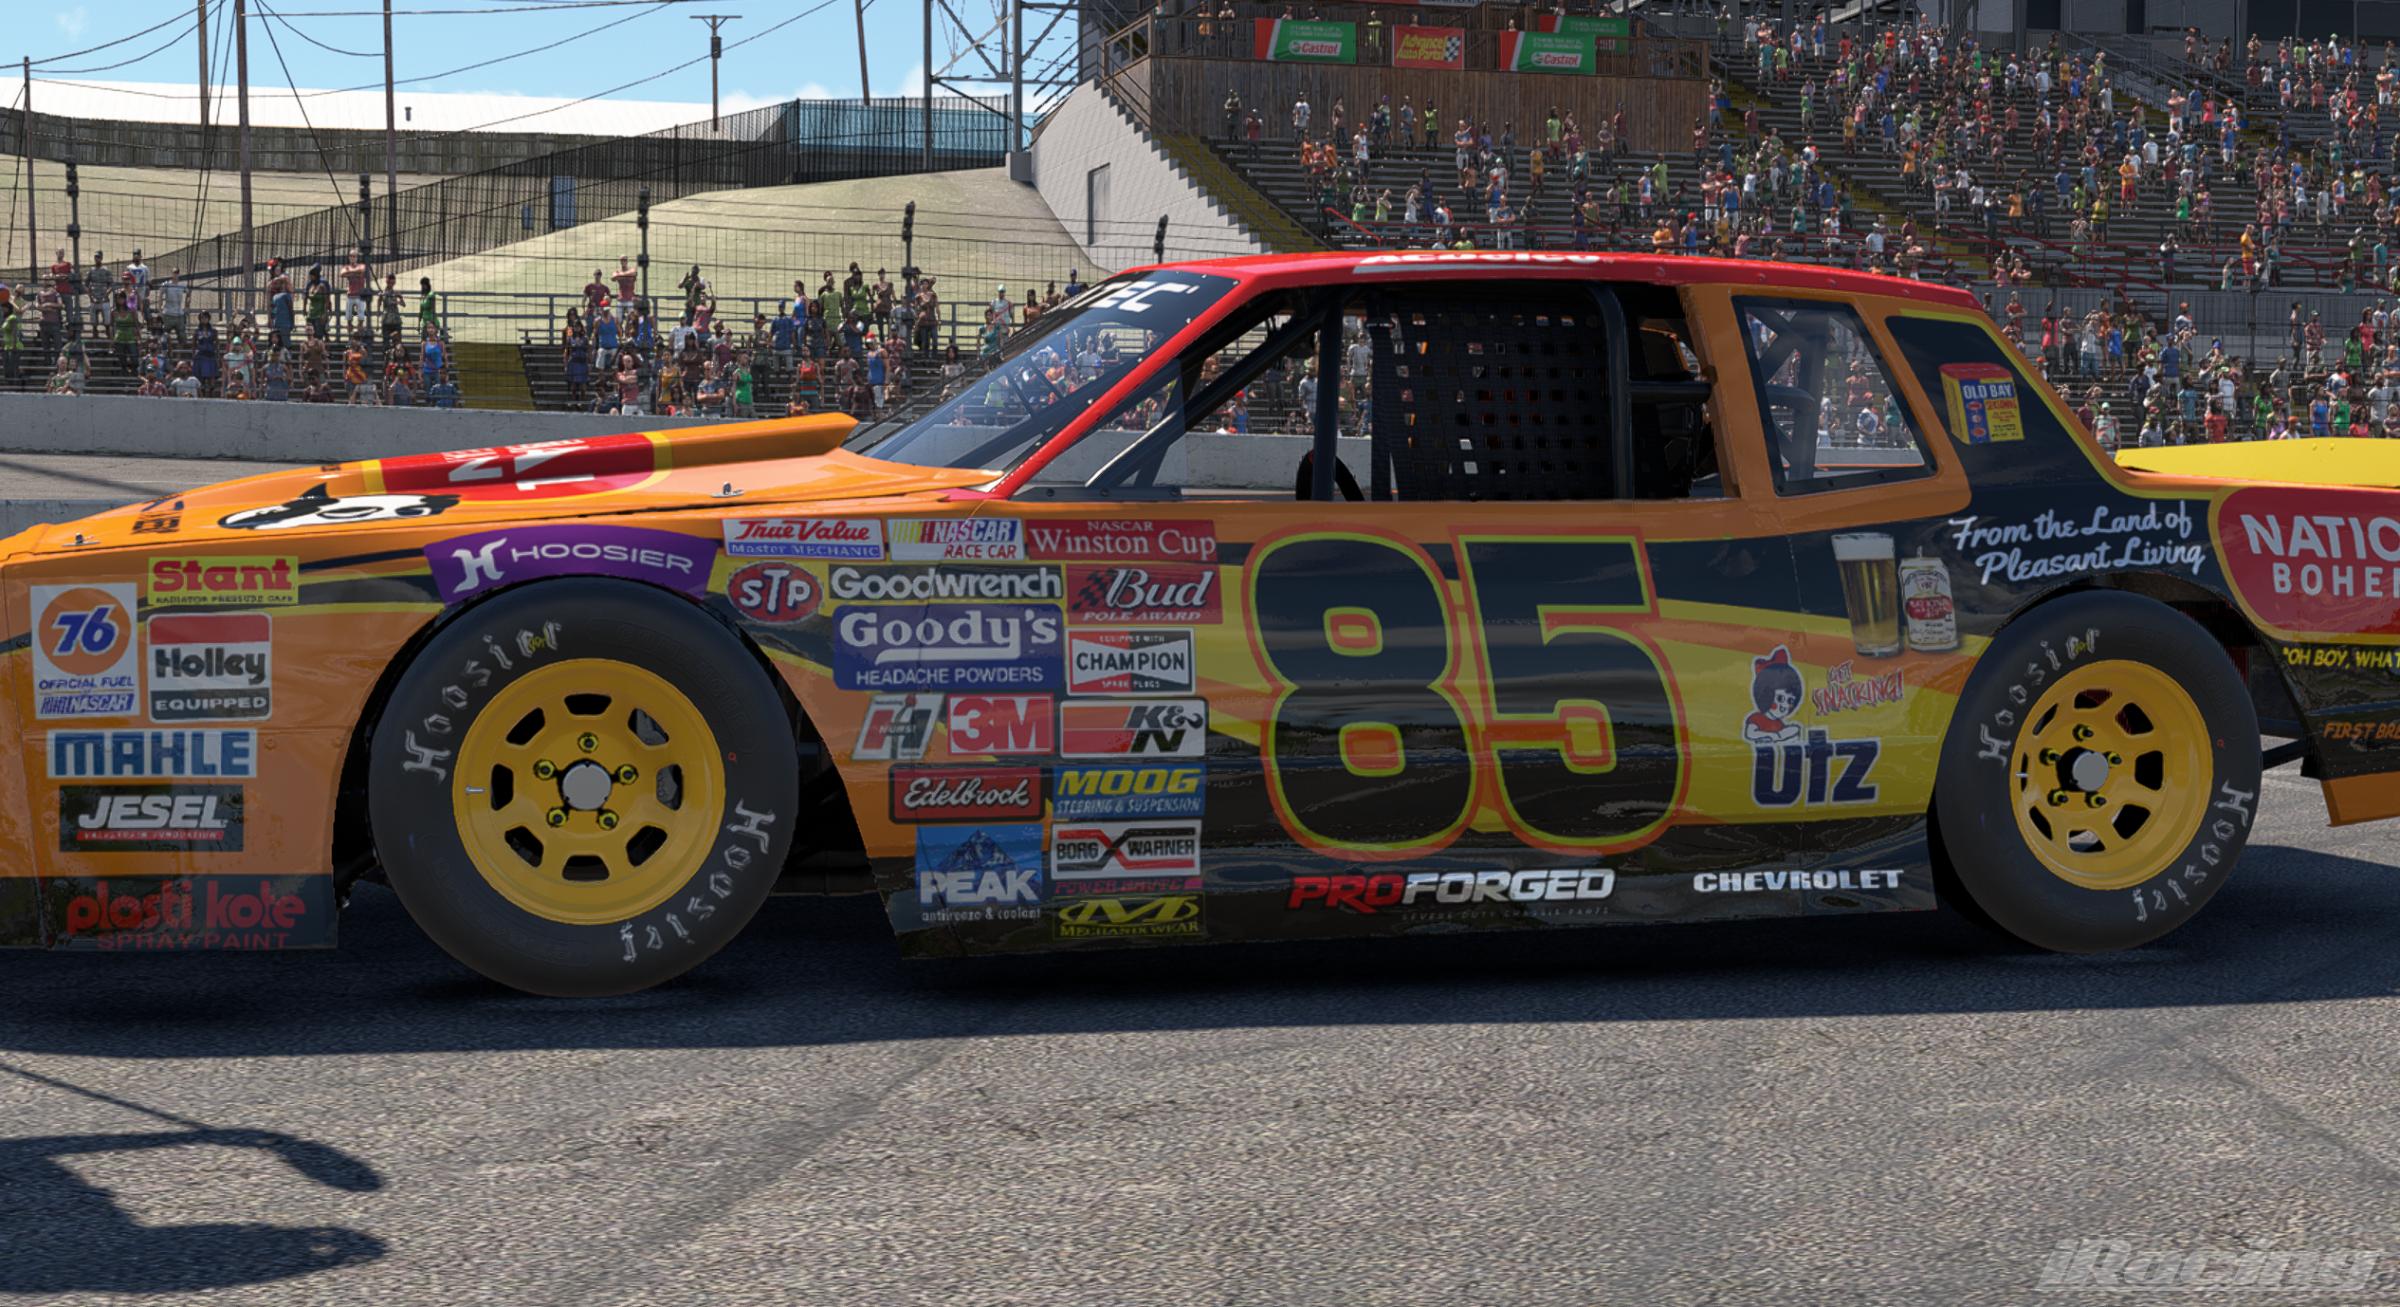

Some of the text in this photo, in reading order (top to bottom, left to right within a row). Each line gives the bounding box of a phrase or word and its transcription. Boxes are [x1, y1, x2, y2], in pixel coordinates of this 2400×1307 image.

[1302, 43, 1338, 54] Castrol
[1543, 54, 1579, 66] Castrol
[1963, 383, 2012, 400] OLD BAY
[934, 521, 1011, 543] NASCAR
[1087, 521, 1155, 532] NASCAR
[1947, 501, 2192, 550] From the Land of
[511, 542, 694, 574] HOOSIER
[790, 544, 881, 558] MECHANIC
[944, 544, 1017, 559] RACE CAR
[1029, 528, 1217, 561] Winston Cup
[153, 558, 293, 592] Stant
[1976, 537, 2205, 586] Pleasant Living
[738, 567, 812, 612] STP
[831, 566, 1063, 599] Goodwrench
[1106, 570, 1216, 609] Bud
[2273, 563, 2400, 598] BOHE
[52, 608, 118, 656] 76
[840, 609, 1058, 652] Goody's
[1081, 611, 1202, 622] POLE AWARD
[155, 648, 266, 685] Holley
[856, 666, 1044, 686] HEADACHE POWDERS
[1076, 651, 1185, 671] CHAMPION
[2313, 649, 2351, 670] BOY,
[39, 675, 135, 690] OFFICIAL FUEL
[1241, 523, 1692, 861] 85
[1977, 627, 2100, 766] Hoosier
[155, 697, 267, 712] EQUIPPED
[402, 620, 562, 785] Hoosier
[952, 697, 1054, 753] 3M
[2322, 721, 2376, 740] FIRST
[55, 731, 250, 776] MAHLE
[903, 777, 1031, 808] Edelbrock
[1058, 768, 1201, 796] MOOG
[78, 796, 226, 829] JESEL
[1056, 797, 1201, 815] STEERING & SUSPENSION
[1056, 839, 1196, 860] BORG WARNER
[2131, 780, 2254, 922] Hoosier
[620, 799, 777, 962] Hoosier
[920, 871, 1039, 904] PEAK
[1287, 867, 1616, 912] PROFORGED
[1693, 869, 1904, 892] CHEVROLET
[66, 880, 306, 935] plasti kote
[97, 932, 291, 952] SPRAY PAINT
